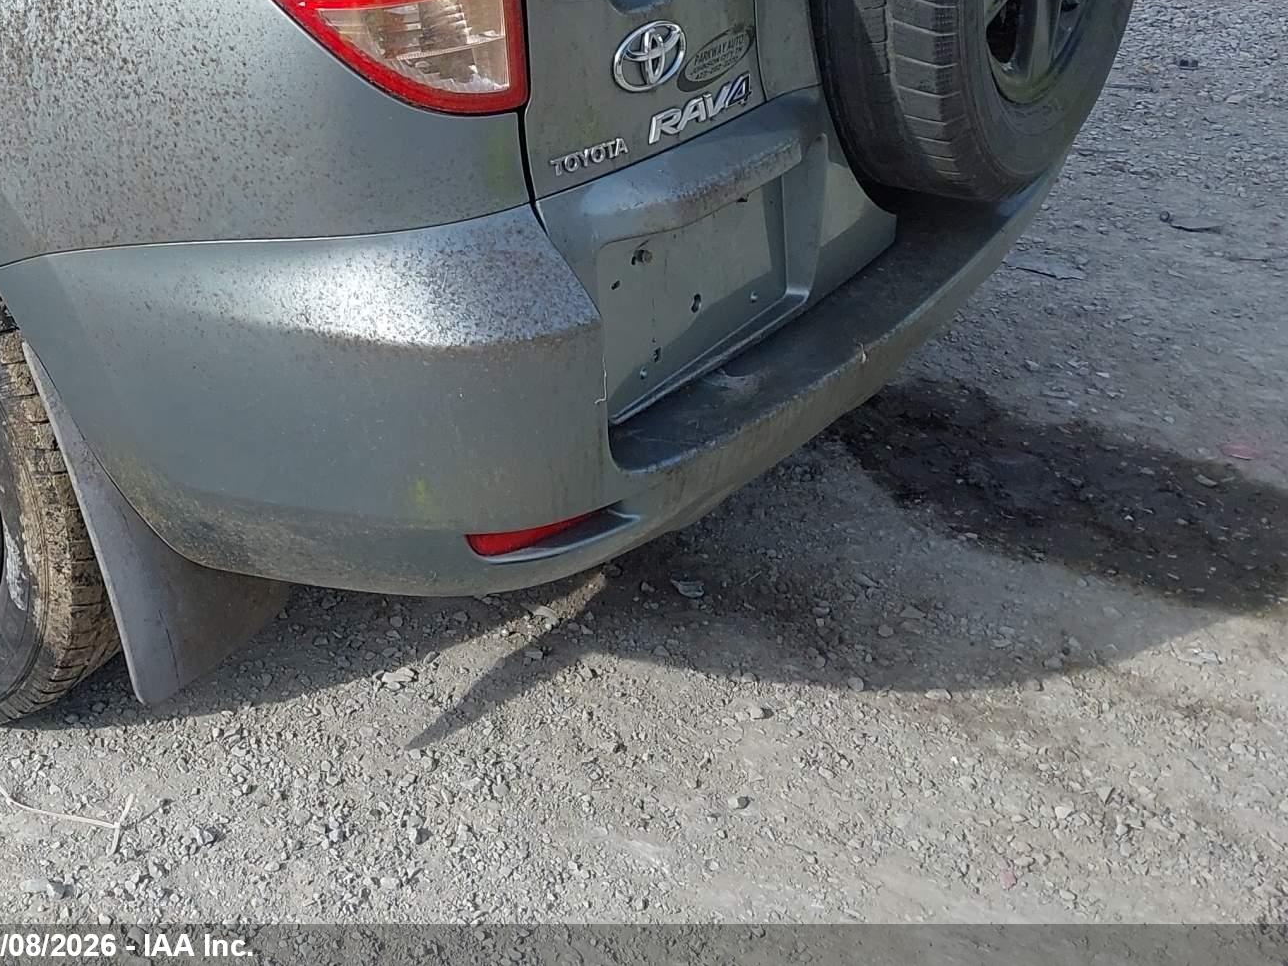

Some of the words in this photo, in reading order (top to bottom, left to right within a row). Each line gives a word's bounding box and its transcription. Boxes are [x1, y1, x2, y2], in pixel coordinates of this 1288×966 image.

[694, 40, 728, 66] PARKWAY
[648, 73, 752, 145] RAV4
[550, 138, 629, 176] TOYOTA
